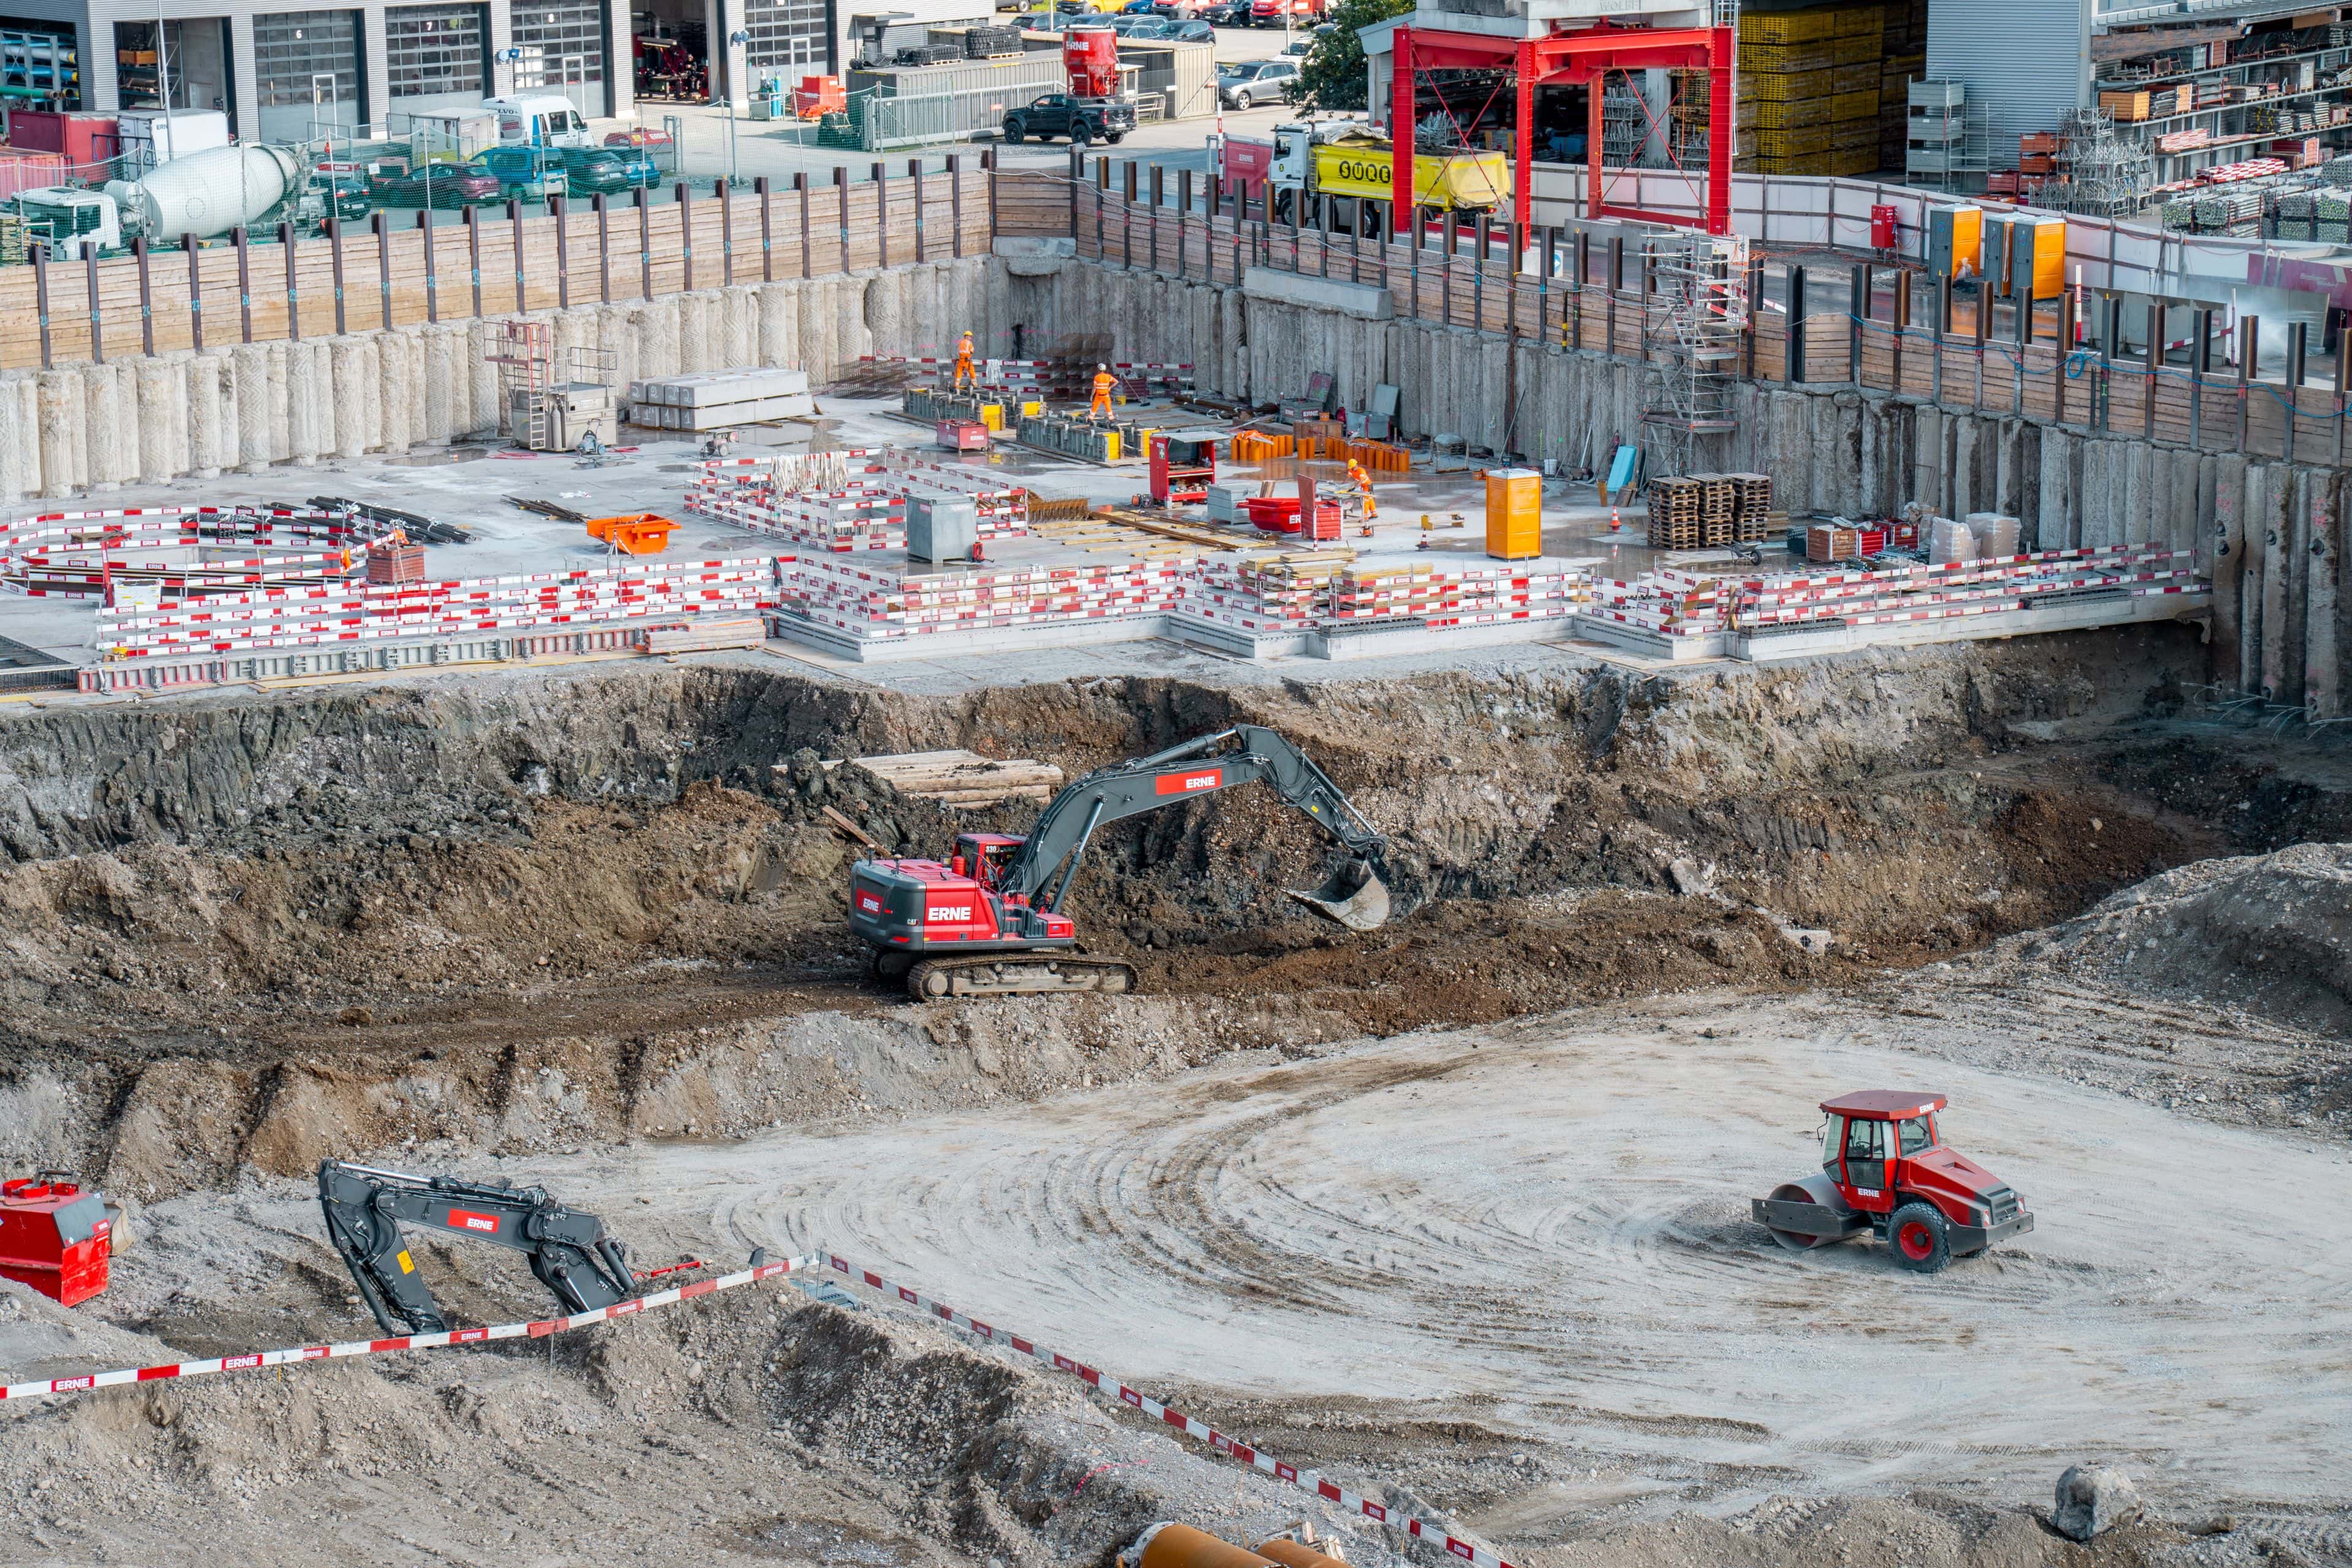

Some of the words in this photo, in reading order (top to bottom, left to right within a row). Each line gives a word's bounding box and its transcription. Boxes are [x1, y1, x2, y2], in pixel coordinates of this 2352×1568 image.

[426, 22, 432, 30] 7
[296, 30, 302, 39] 6
[1066, 42, 1089, 51] ERNE
[1239, 154, 1253, 163] ERNE
[1340, 162, 1390, 183] SURE
[336, 288, 342, 299] 30
[382, 282, 389, 294] 31
[665, 408, 671, 422] 1
[685, 411, 691, 423] 1
[1289, 515, 1300, 523] ER
[1186, 776, 1215, 789] ERNE
[863, 898, 879, 912] ERNE
[928, 907, 971, 920] ERNE
[1919, 1103, 1934, 1113] ERNE
[1858, 1188, 1879, 1197] ERNE
[467, 1218, 493, 1230] ERNE
[764, 1265, 784, 1276] ERNE
[617, 1304, 637, 1313] ERNE
[461, 1332, 481, 1340] ERNE
[977, 1326, 988, 1336] ERNE
[225, 1357, 258, 1368] ERNE
[1060, 1360, 1072, 1370] ERNE
[56, 1378, 89, 1390] ERNE
[1126, 1392, 1138, 1404] ERNE
[1215, 1437, 1229, 1449] ERNE
[1281, 1468, 1293, 1479] ERNE
[1369, 1506, 1381, 1518] ERNE
[1454, 1544, 1468, 1556] ERNE
